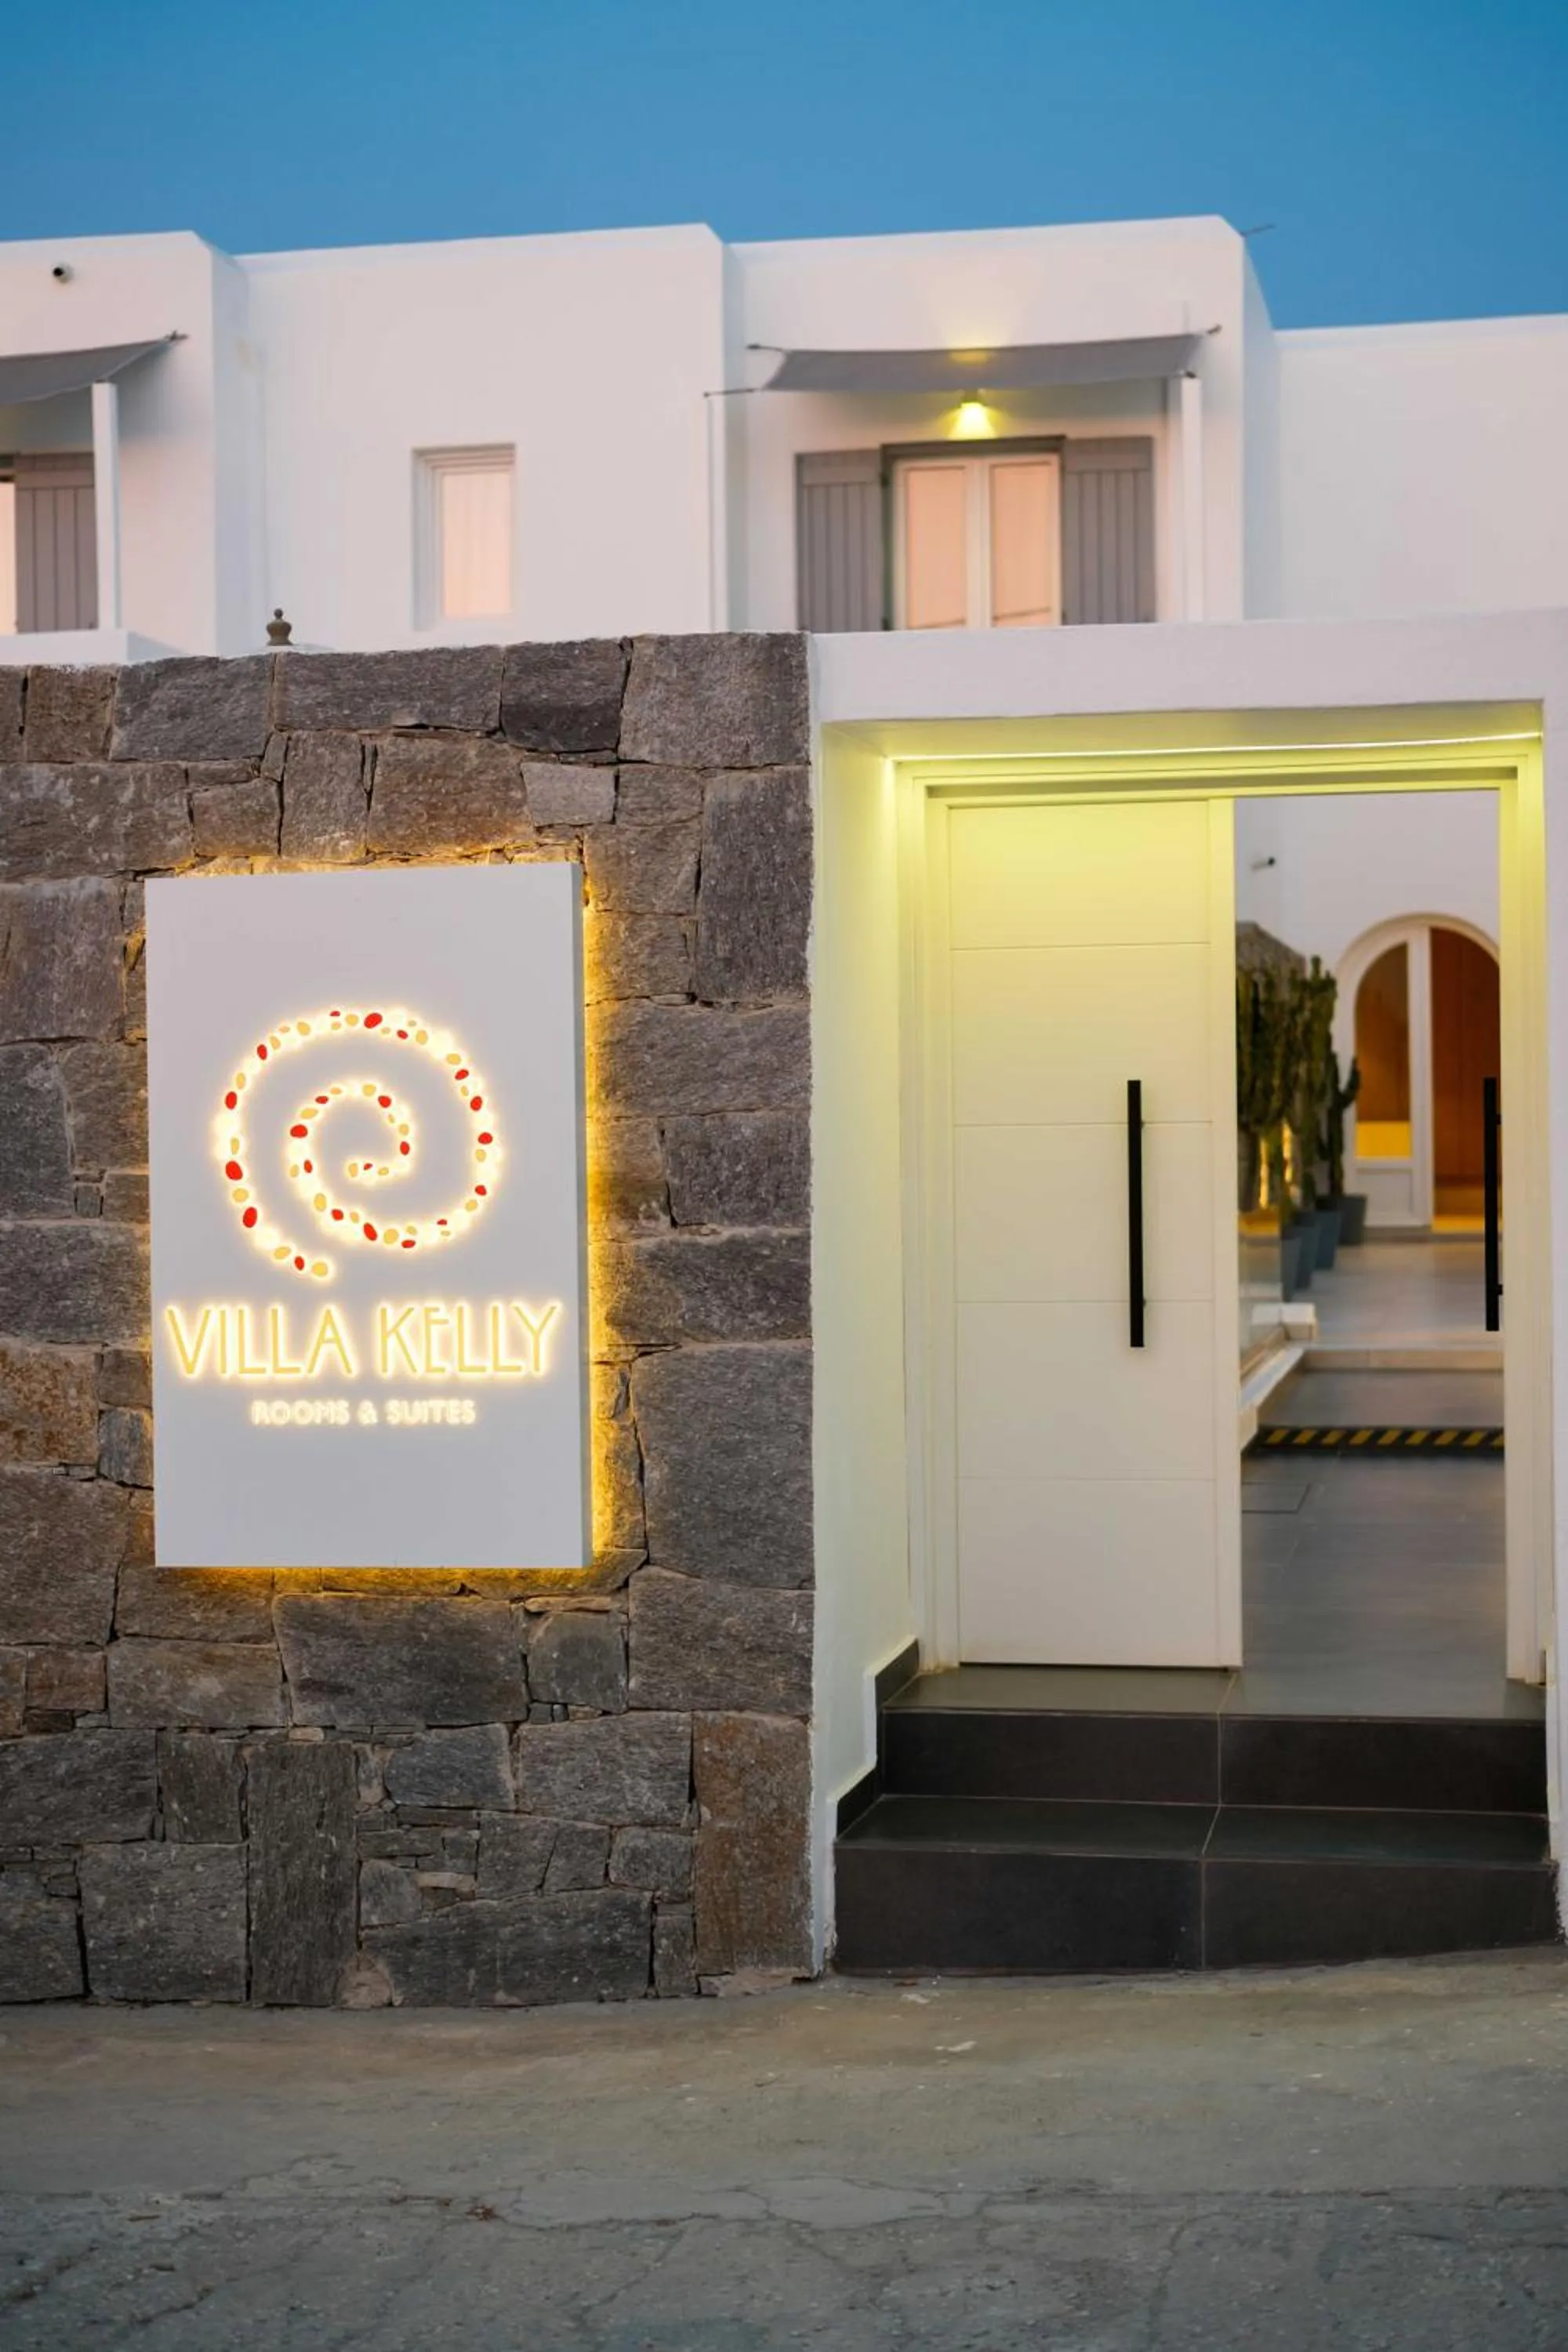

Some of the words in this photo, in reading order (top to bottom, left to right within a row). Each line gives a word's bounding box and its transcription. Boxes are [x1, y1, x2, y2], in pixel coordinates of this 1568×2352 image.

[165, 1305, 355, 1377] VILLA
[378, 1303, 559, 1375] KELLY
[251, 1399, 350, 1425] ROOMS
[357, 1399, 379, 1425] &
[387, 1399, 477, 1425] SUITES
